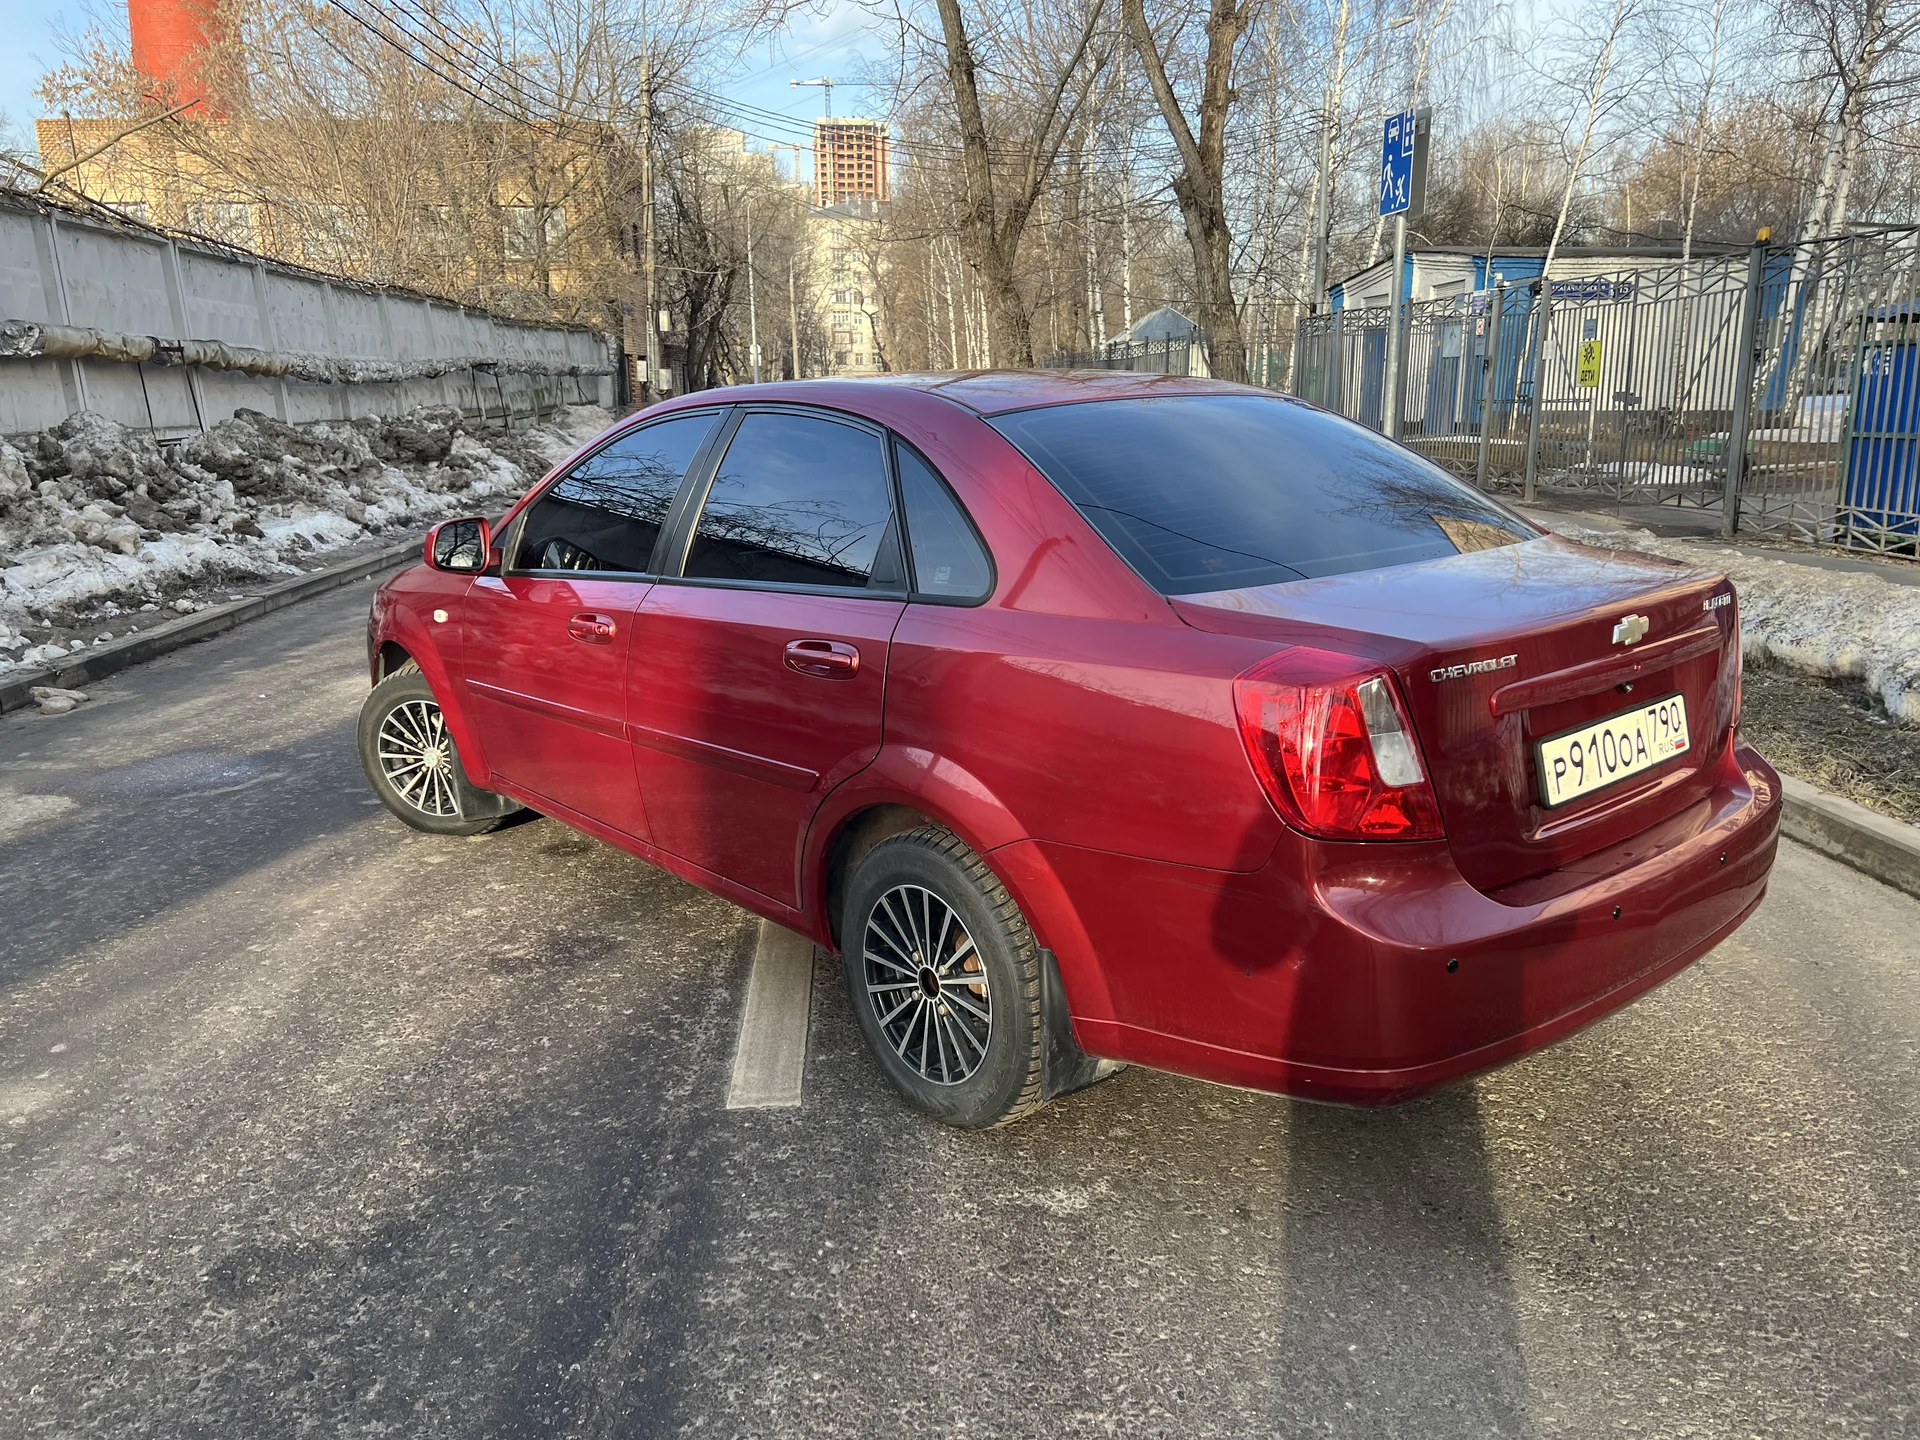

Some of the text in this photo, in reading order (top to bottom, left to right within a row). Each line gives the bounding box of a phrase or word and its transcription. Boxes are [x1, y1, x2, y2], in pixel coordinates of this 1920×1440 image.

[1580, 370, 1595, 381] ДЕТИ
[1430, 654, 1518, 683] CHEVROLET
[1648, 701, 1682, 743] 790
[1658, 739, 1675, 755] RUS
